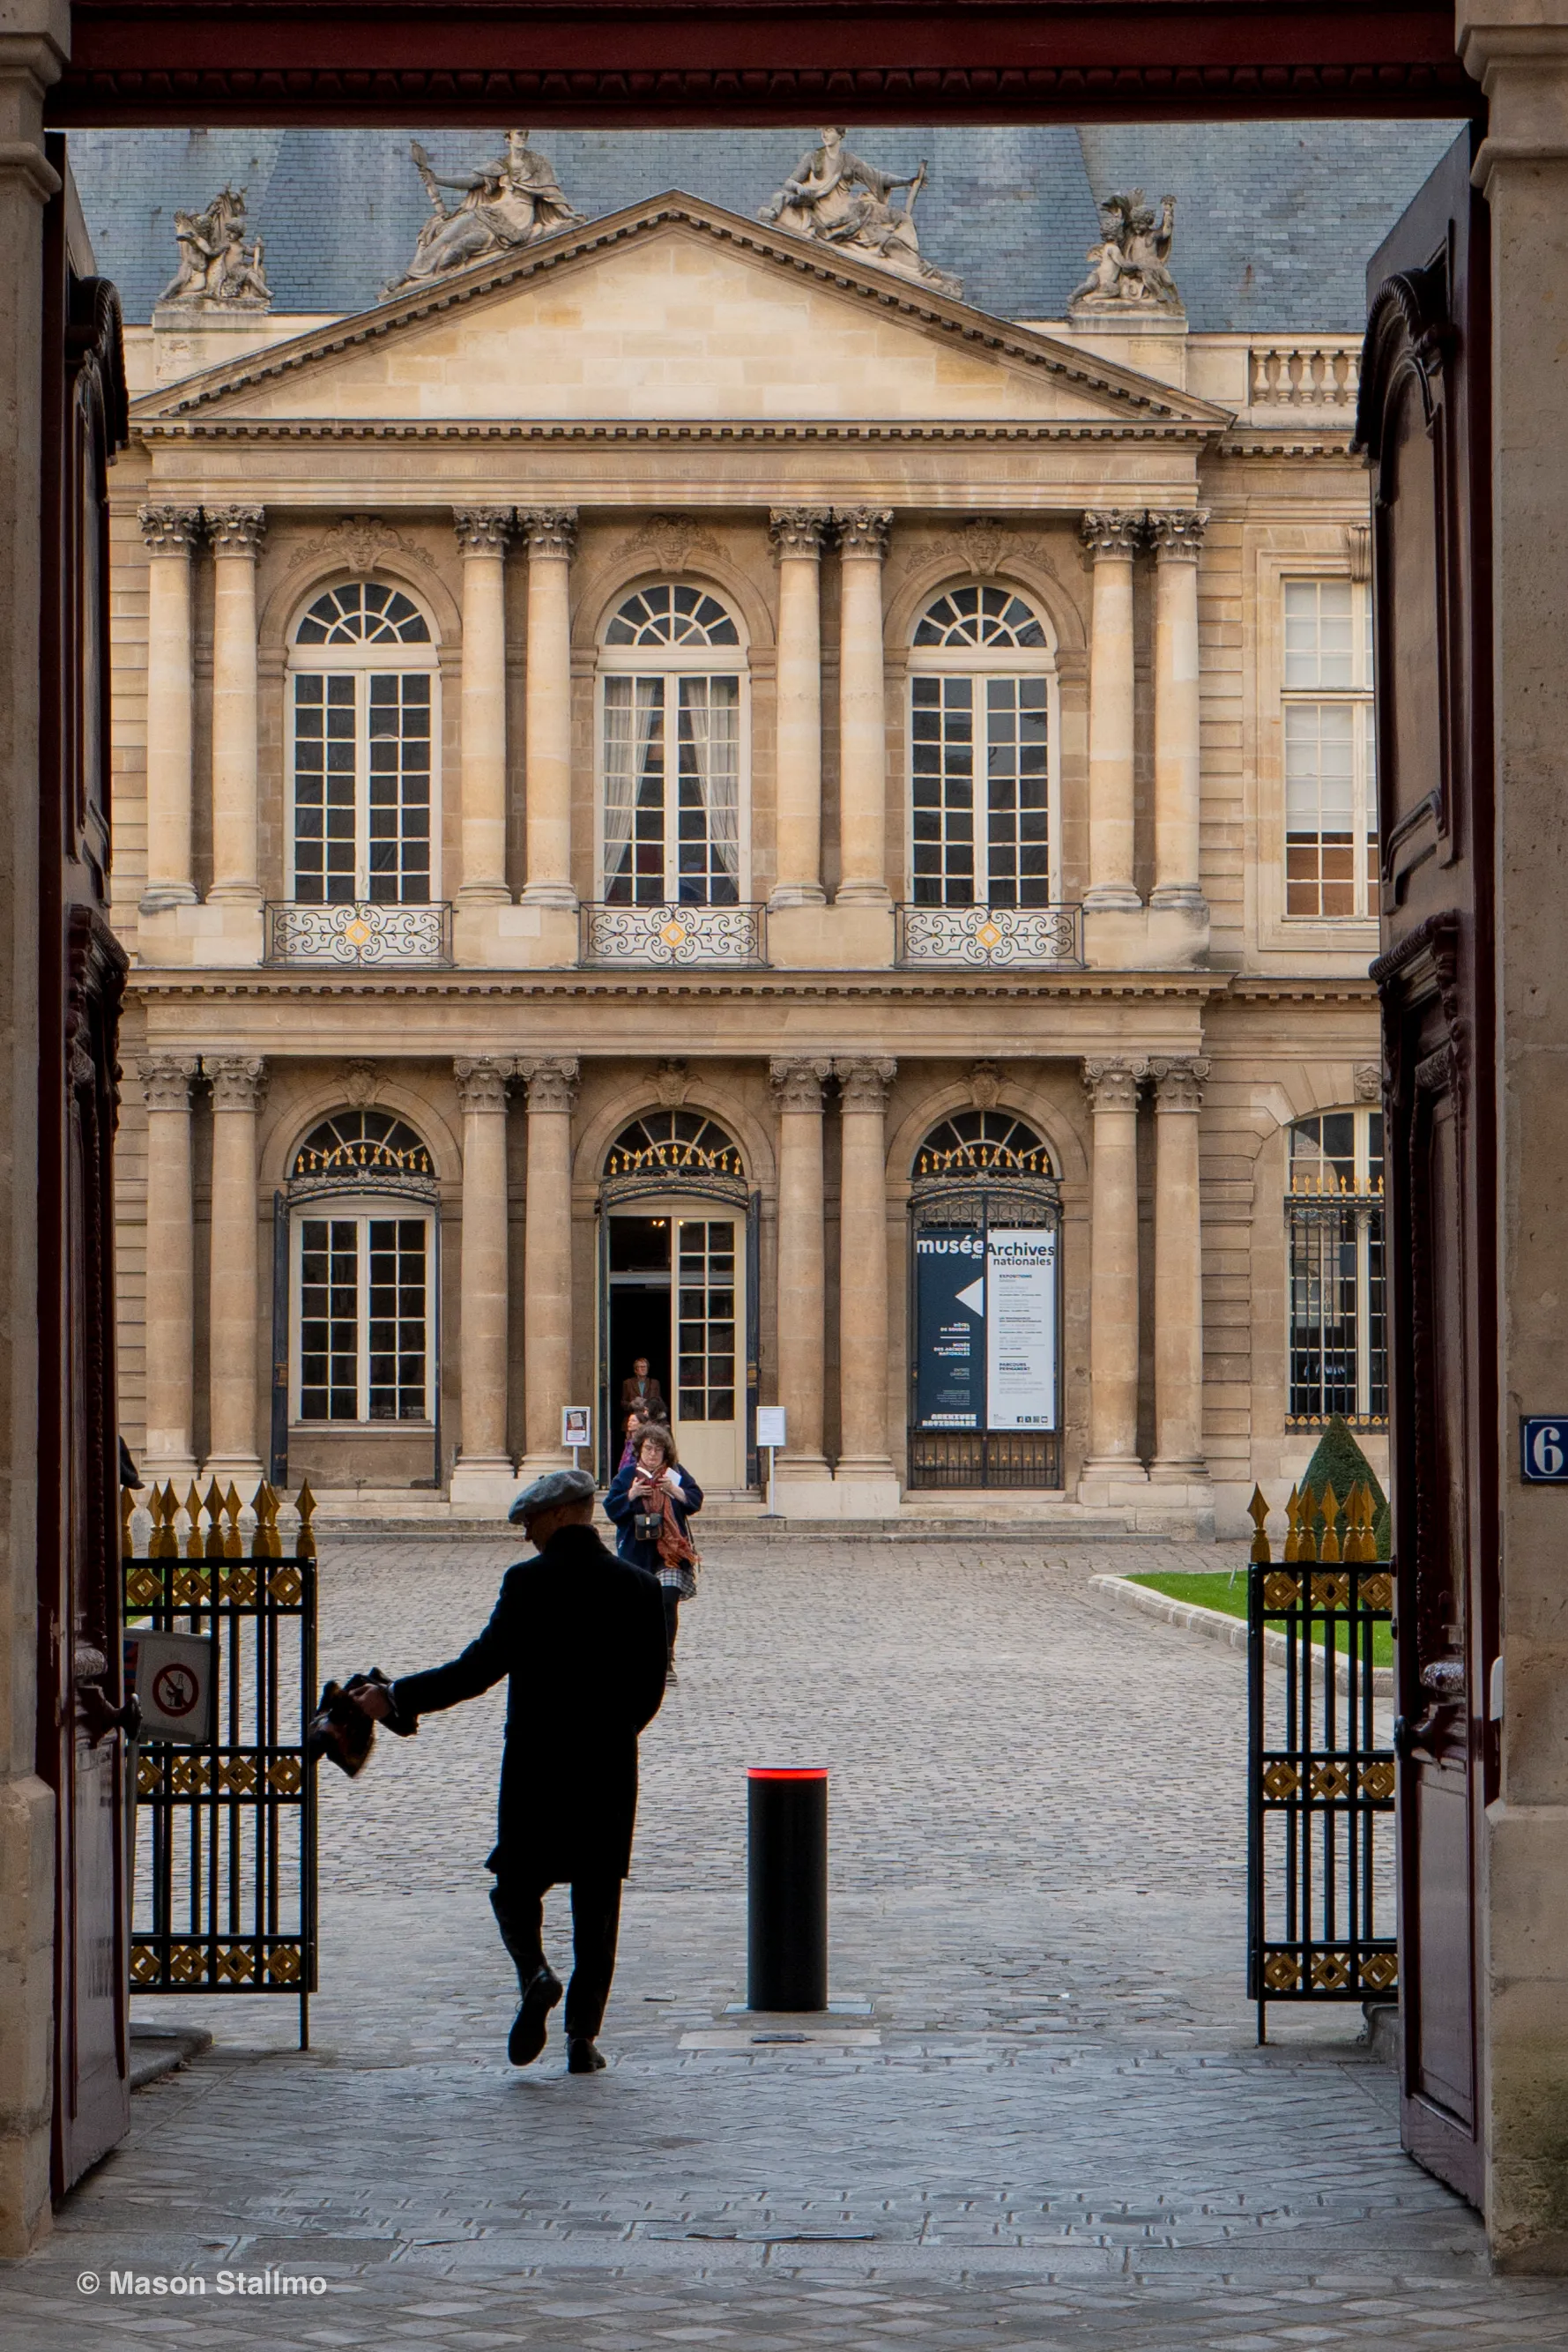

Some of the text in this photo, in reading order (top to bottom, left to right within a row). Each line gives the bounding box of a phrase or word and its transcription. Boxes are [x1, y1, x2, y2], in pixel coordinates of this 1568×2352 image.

[917, 1235, 984, 1254] musée
[987, 1242, 1054, 1256] Archives
[993, 1257, 1052, 1266] nationales
[1534, 1426, 1564, 1474] 6
